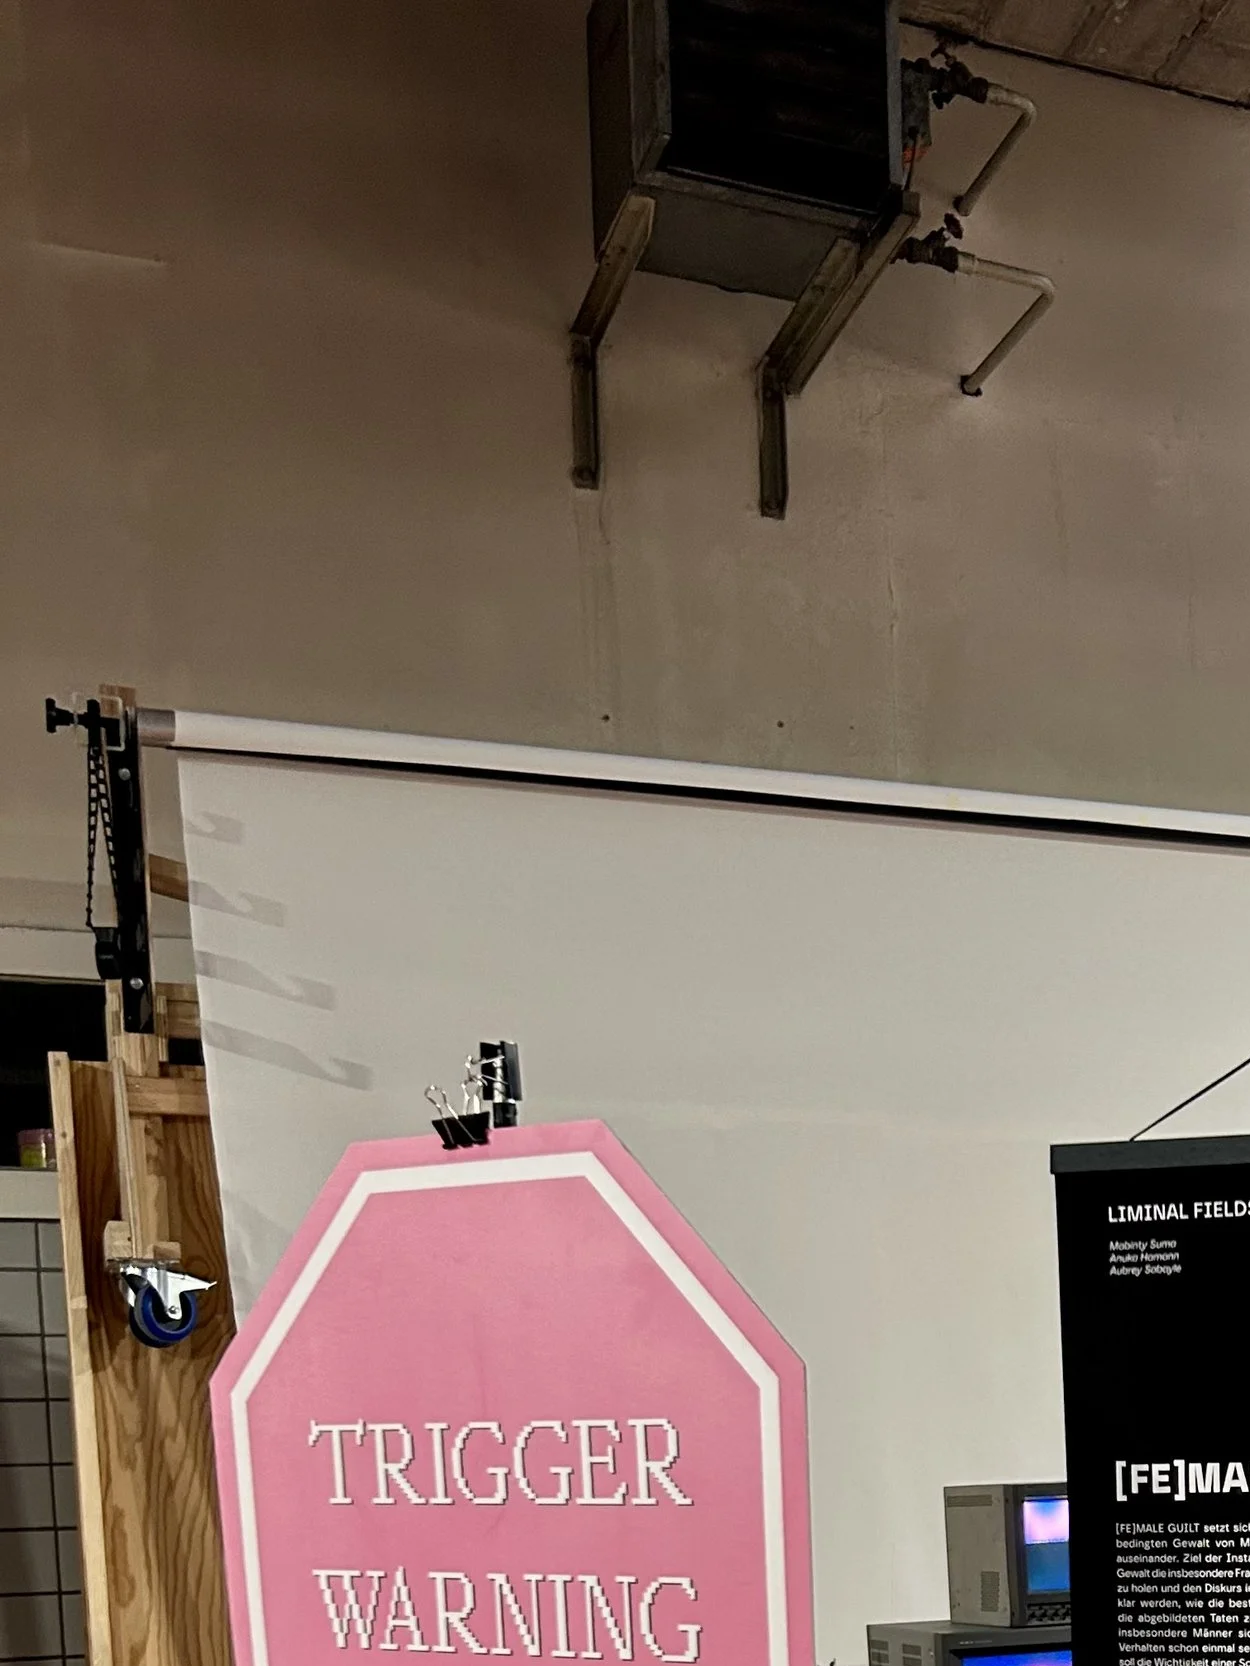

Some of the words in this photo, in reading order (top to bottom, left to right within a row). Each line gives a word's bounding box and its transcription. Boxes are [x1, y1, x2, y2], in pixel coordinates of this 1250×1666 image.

[1108, 1203, 1189, 1223] LIMINAL
[309, 1418, 694, 1505] TRIGGER
[1115, 1523, 1164, 1535] [FE]MALE
[1167, 1523, 1200, 1533] GUILT
[1203, 1523, 1230, 1532] setzt
[1115, 1539, 1168, 1550] bedingten
[1172, 1538, 1210, 1547] Gewalt
[1115, 1554, 1179, 1563] auseinander.
[1182, 1553, 1202, 1562] Ziel
[1116, 1568, 1150, 1578] Gewalt
[1167, 1568, 1234, 1578] insbesondere
[1131, 1583, 1158, 1592] holen
[1204, 1583, 1242, 1593] Diskurs
[1139, 1598, 1181, 1608] werden,
[312, 1566, 703, 1663] WARNING
[1137, 1613, 1205, 1625] abgebildeten
[1209, 1613, 1239, 1623] Taten
[1118, 1628, 1187, 1637] insbesondere
[1192, 1628, 1233, 1638] Männer
[1118, 1642, 1165, 1652] Verhalten
[1168, 1643, 1199, 1652] schon
[1201, 1643, 1235, 1653] einmal
